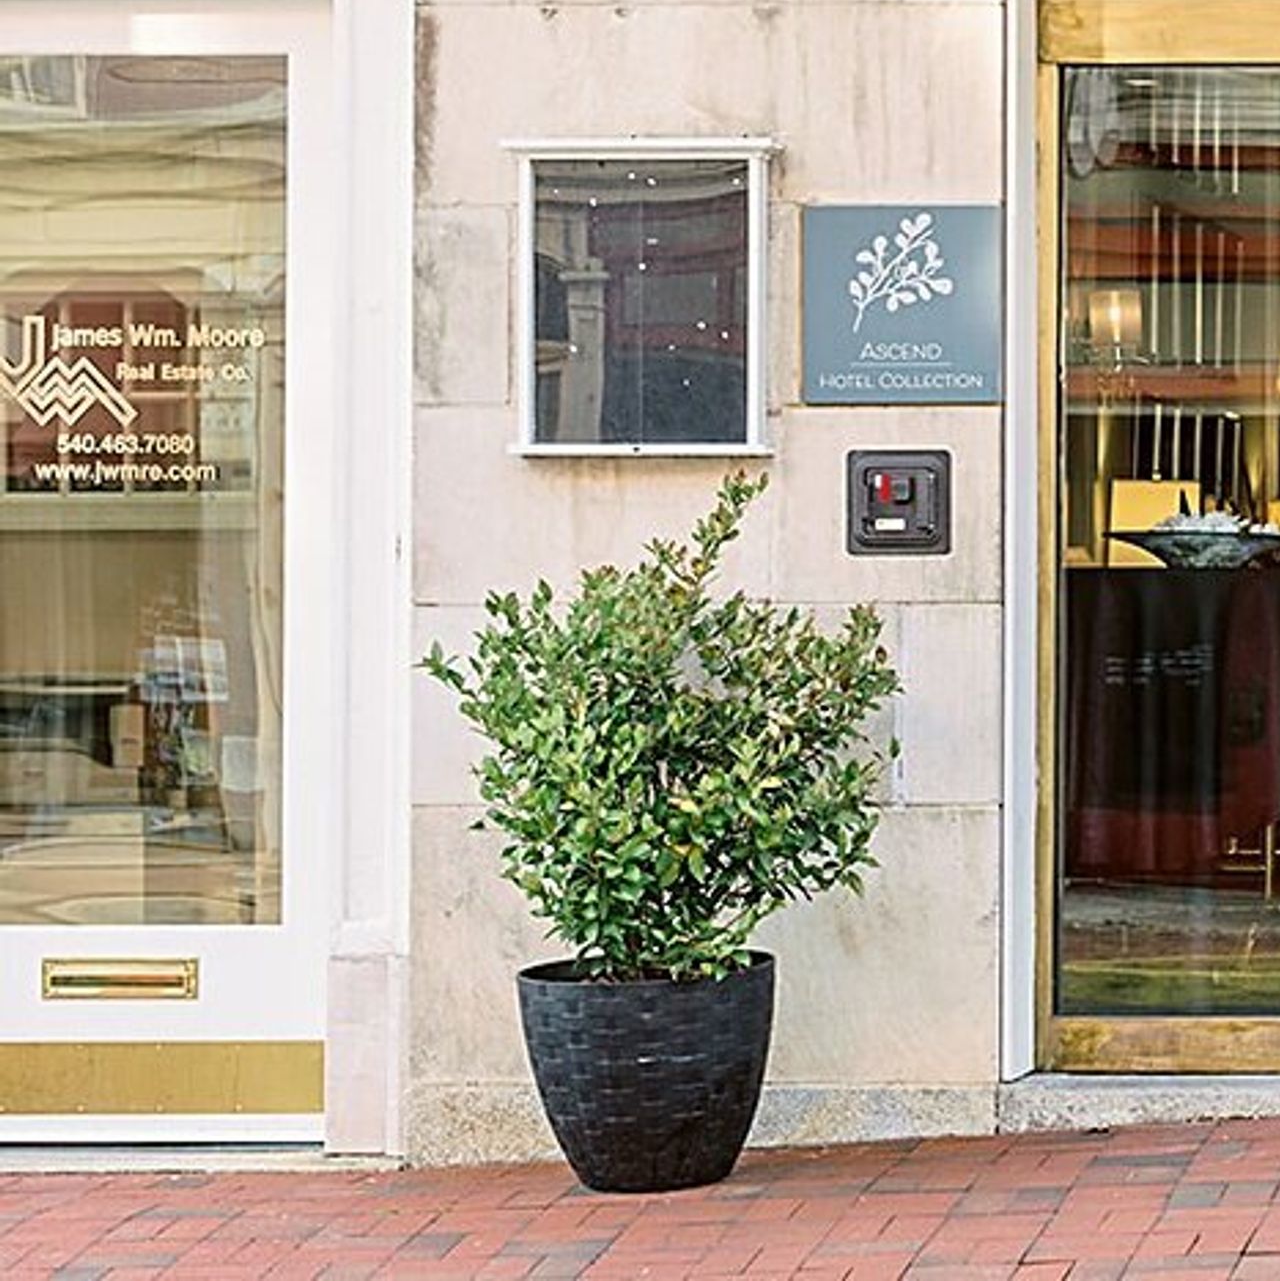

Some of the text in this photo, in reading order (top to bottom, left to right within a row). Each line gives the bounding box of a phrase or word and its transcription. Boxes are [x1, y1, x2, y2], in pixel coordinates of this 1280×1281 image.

[52, 324, 265, 351] James Wm. Moore
[860, 343, 942, 361] ASCEND
[116, 363, 249, 380] Real Estate Co.
[820, 372, 984, 389] HOTEL COLLECTION
[34, 460, 217, 484] www.jwmre.com
